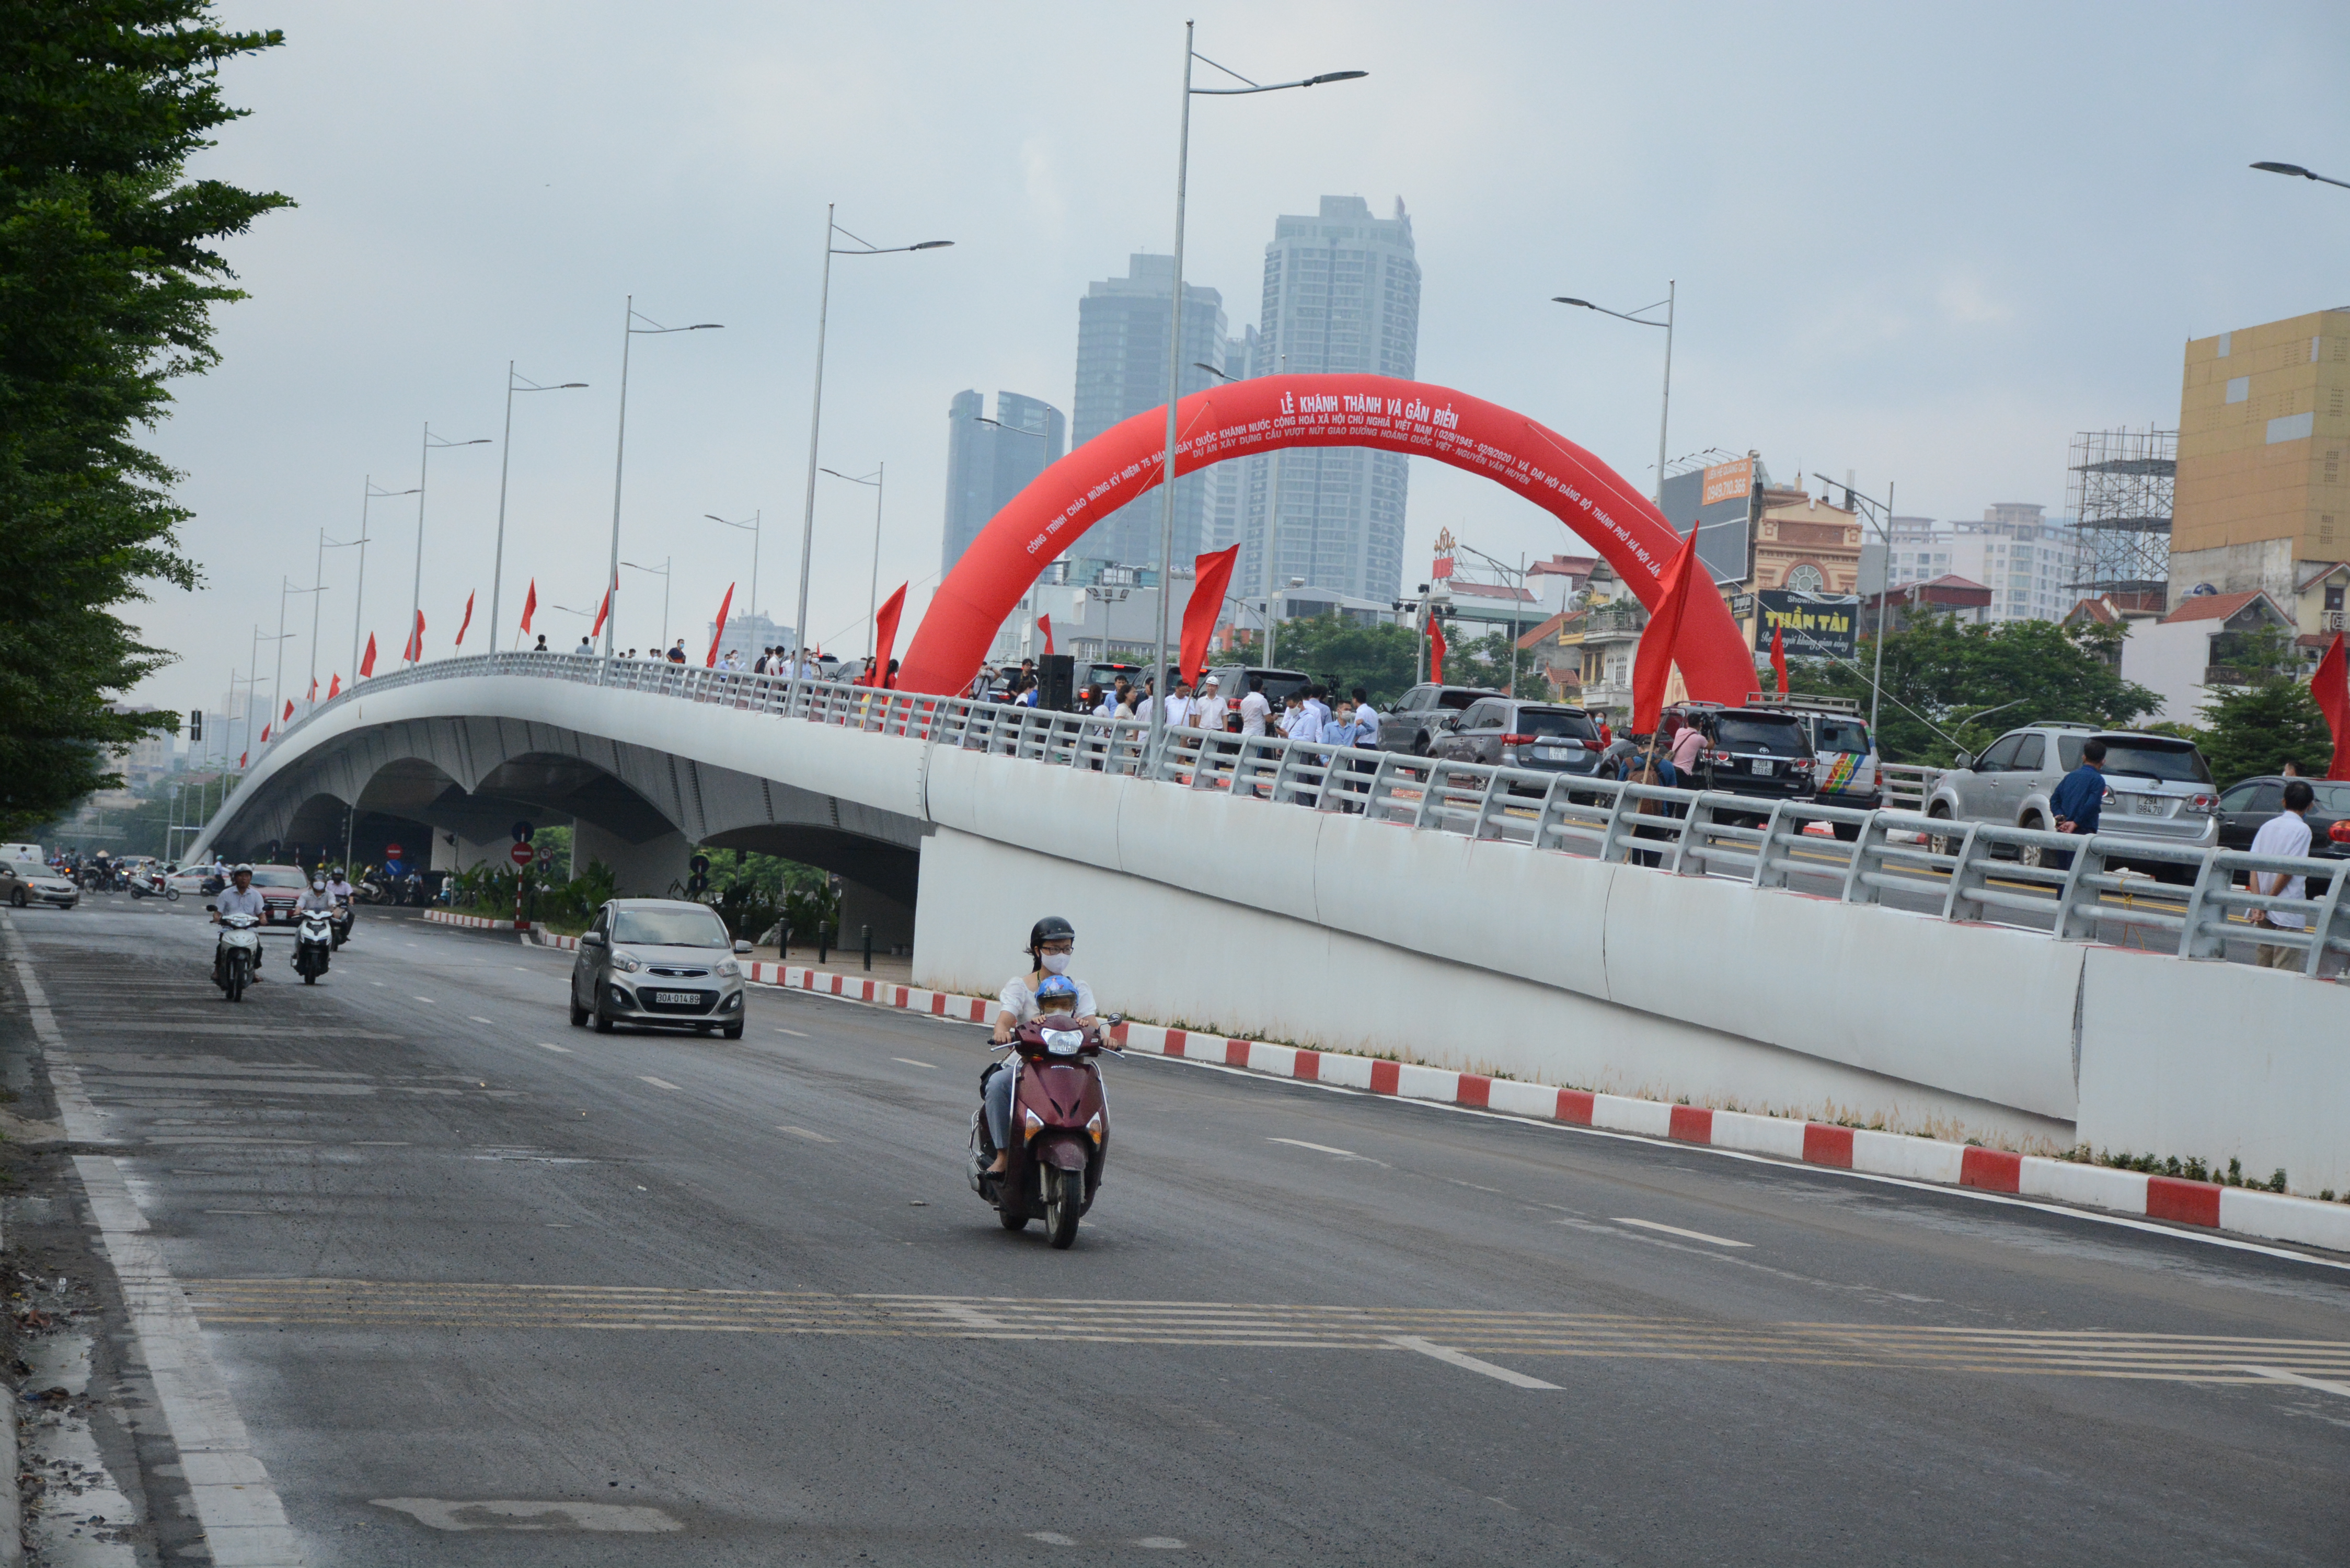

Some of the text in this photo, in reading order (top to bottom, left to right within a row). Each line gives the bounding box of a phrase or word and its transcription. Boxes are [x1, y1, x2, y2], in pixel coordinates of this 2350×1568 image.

[1281, 391, 1295, 414] LỄ
[1300, 393, 1338, 413] KHÁNH
[1343, 393, 1381, 413] THÀNH
[1387, 398, 1402, 417] VÀ
[1432, 403, 1459, 430] BIỂN
[1193, 446, 1204, 458] DỰ
[1207, 443, 1217, 454] ÁN
[1220, 438, 1236, 449] XÂY
[1239, 433, 1262, 445] DỰNG
[1265, 428, 1282, 440] CẦU
[1284, 427, 1305, 436] VƯỢT
[1309, 425, 1325, 435] NÚT
[1328, 426, 1346, 435] GIAO
[1350, 425, 1378, 436] ĐƯỜNG
[1380, 429, 1409, 441] HOÀNG
[1411, 435, 1433, 446] QUỐC
[1436, 440, 1452, 452] VIỆT
[1455, 447, 1488, 465] NGUYỄN
[1488, 459, 1505, 472] VĂN
[1505, 467, 1531, 485] HUYÊN
[1027, 534, 1047, 554] CÔNG
[1045, 514, 1067, 535] TRÌNH
[1067, 498, 1087, 516] CHÀO
[1087, 481, 1111, 501] MỪNG
[1109, 472, 1121, 487] KỶ
[1121, 463, 1141, 480] NIỆM
[1141, 457, 1151, 468] 75
[1195, 431, 1217, 447] QUỐC
[1219, 425, 1247, 439] KHÁNH
[1249, 419, 1271, 432] NƯỚC
[1274, 416, 1296, 428] CỘNG
[1318, 413, 1329, 424] XÃ
[1332, 412, 1345, 425] HỘI
[1347, 412, 1364, 424] CHỦ
[1395, 419, 1412, 431] VIỆT
[1413, 423, 1433, 435] NAM
[1517, 460, 1530, 472] VÀ
[1530, 467, 1546, 480] ĐẠI
[1544, 475, 1560, 489] HỘI
[1558, 483, 1581, 502] ĐẢNG
[1579, 498, 1593, 511] BỘ
[1592, 506, 1616, 529] THÀNH
[1612, 525, 1631, 541] PHỐ
[1626, 539, 1640, 552] HÀ
[1635, 548, 1650, 563] NỘI
[1765, 605, 1849, 632] THẦN TÀI
[1761, 631, 1773, 646] Rạ
[2144, 796, 2157, 804] 29A
